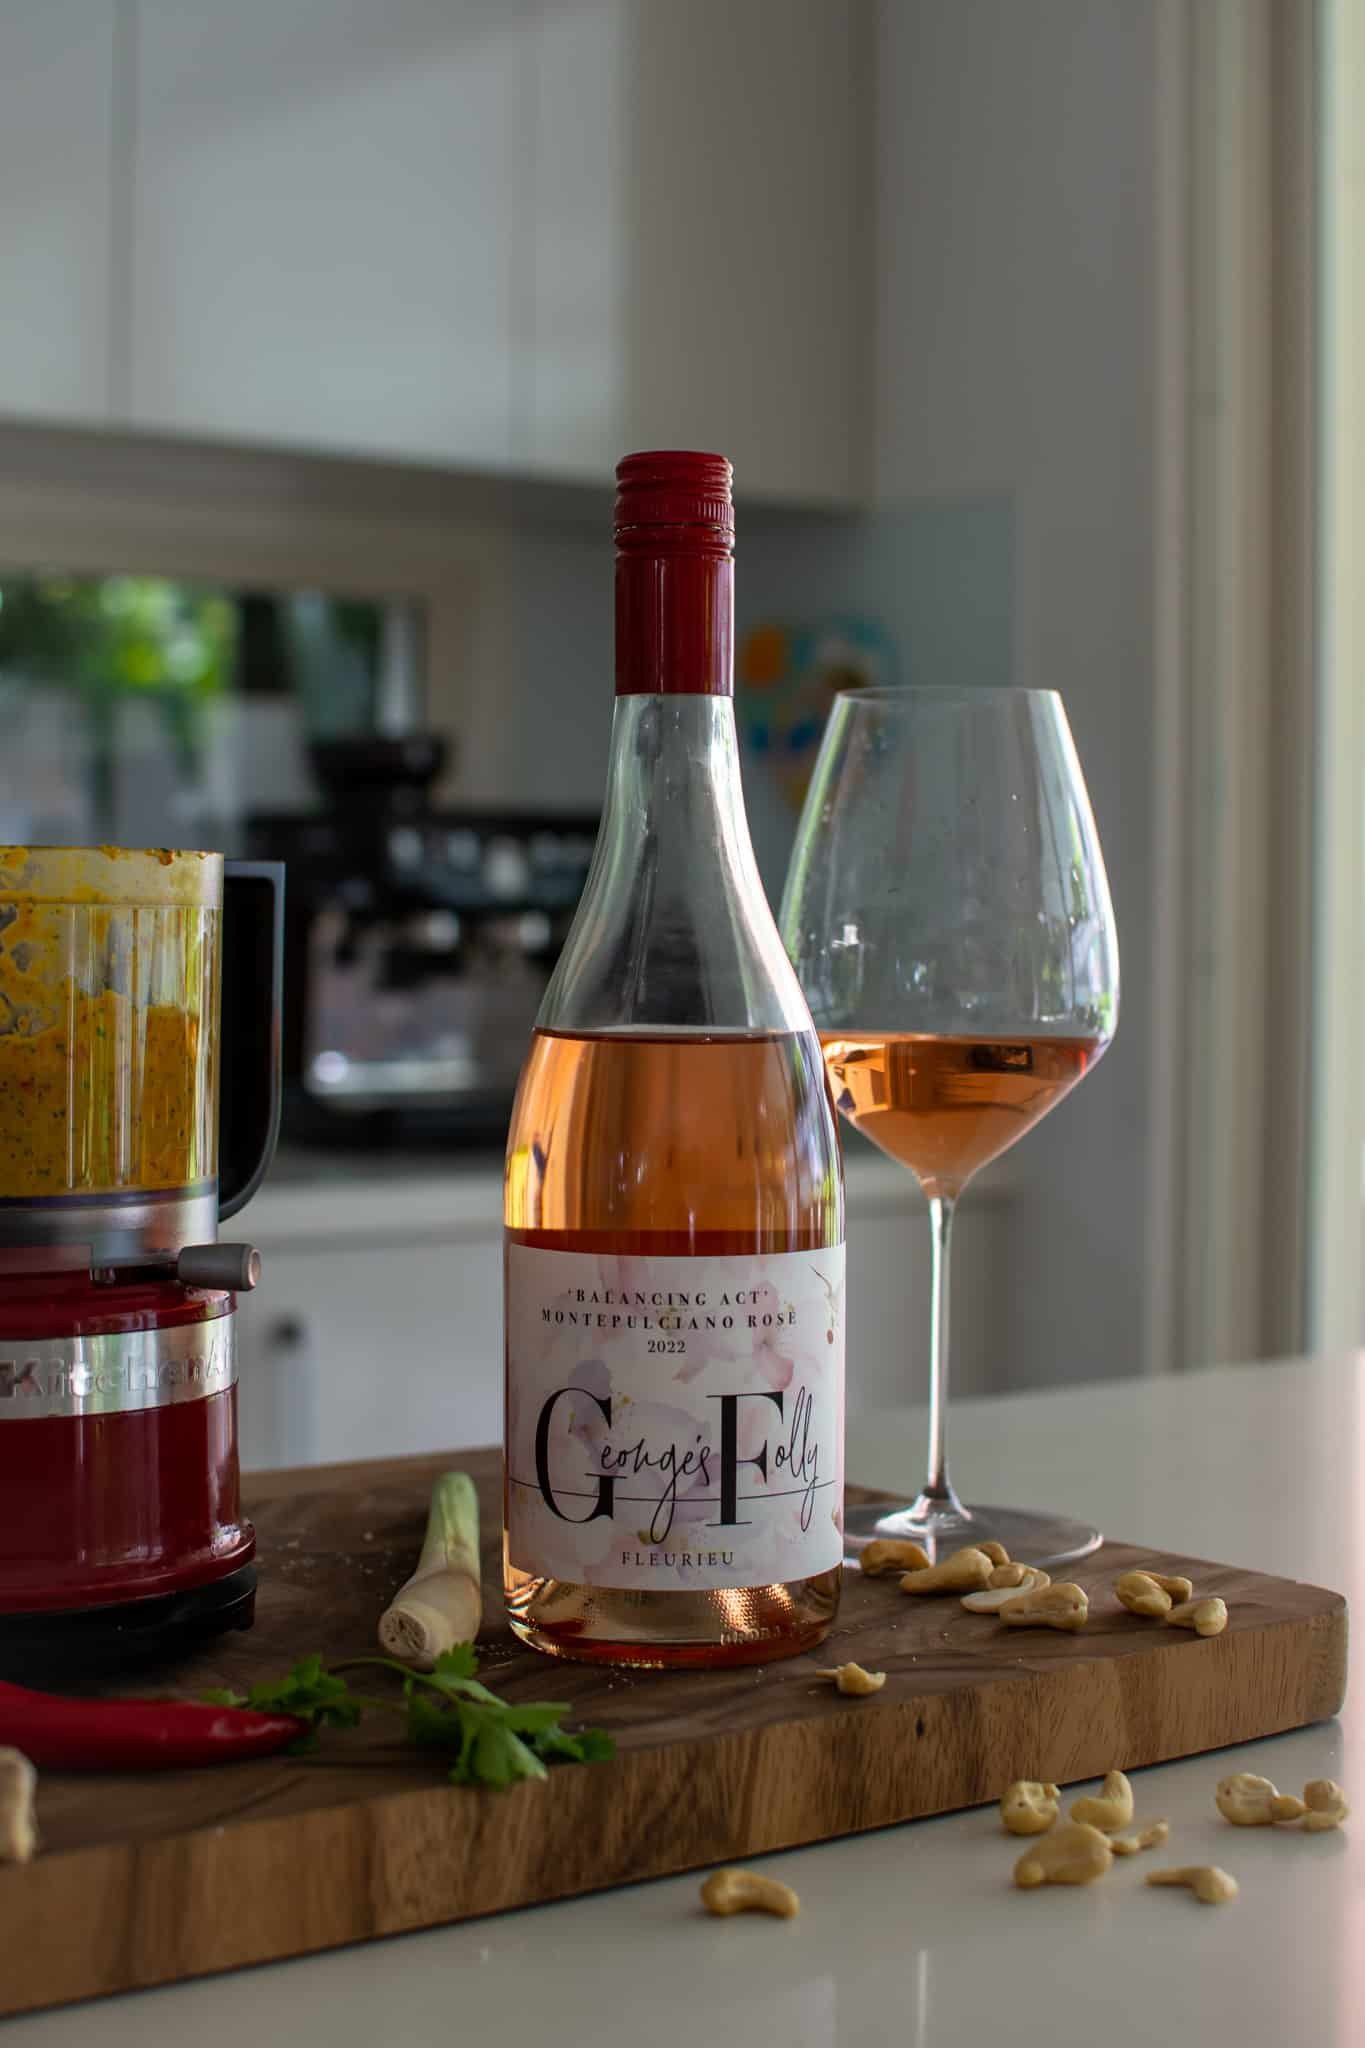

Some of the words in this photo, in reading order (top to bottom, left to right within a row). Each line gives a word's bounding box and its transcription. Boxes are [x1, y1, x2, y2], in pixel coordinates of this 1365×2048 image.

[541, 1308, 736, 1329] MONTEPULCIANO
[647, 1339, 687, 1354] 2022
[705, 1385, 830, 1533] Folly
[621, 1551, 735, 1568] FLEURIEU
